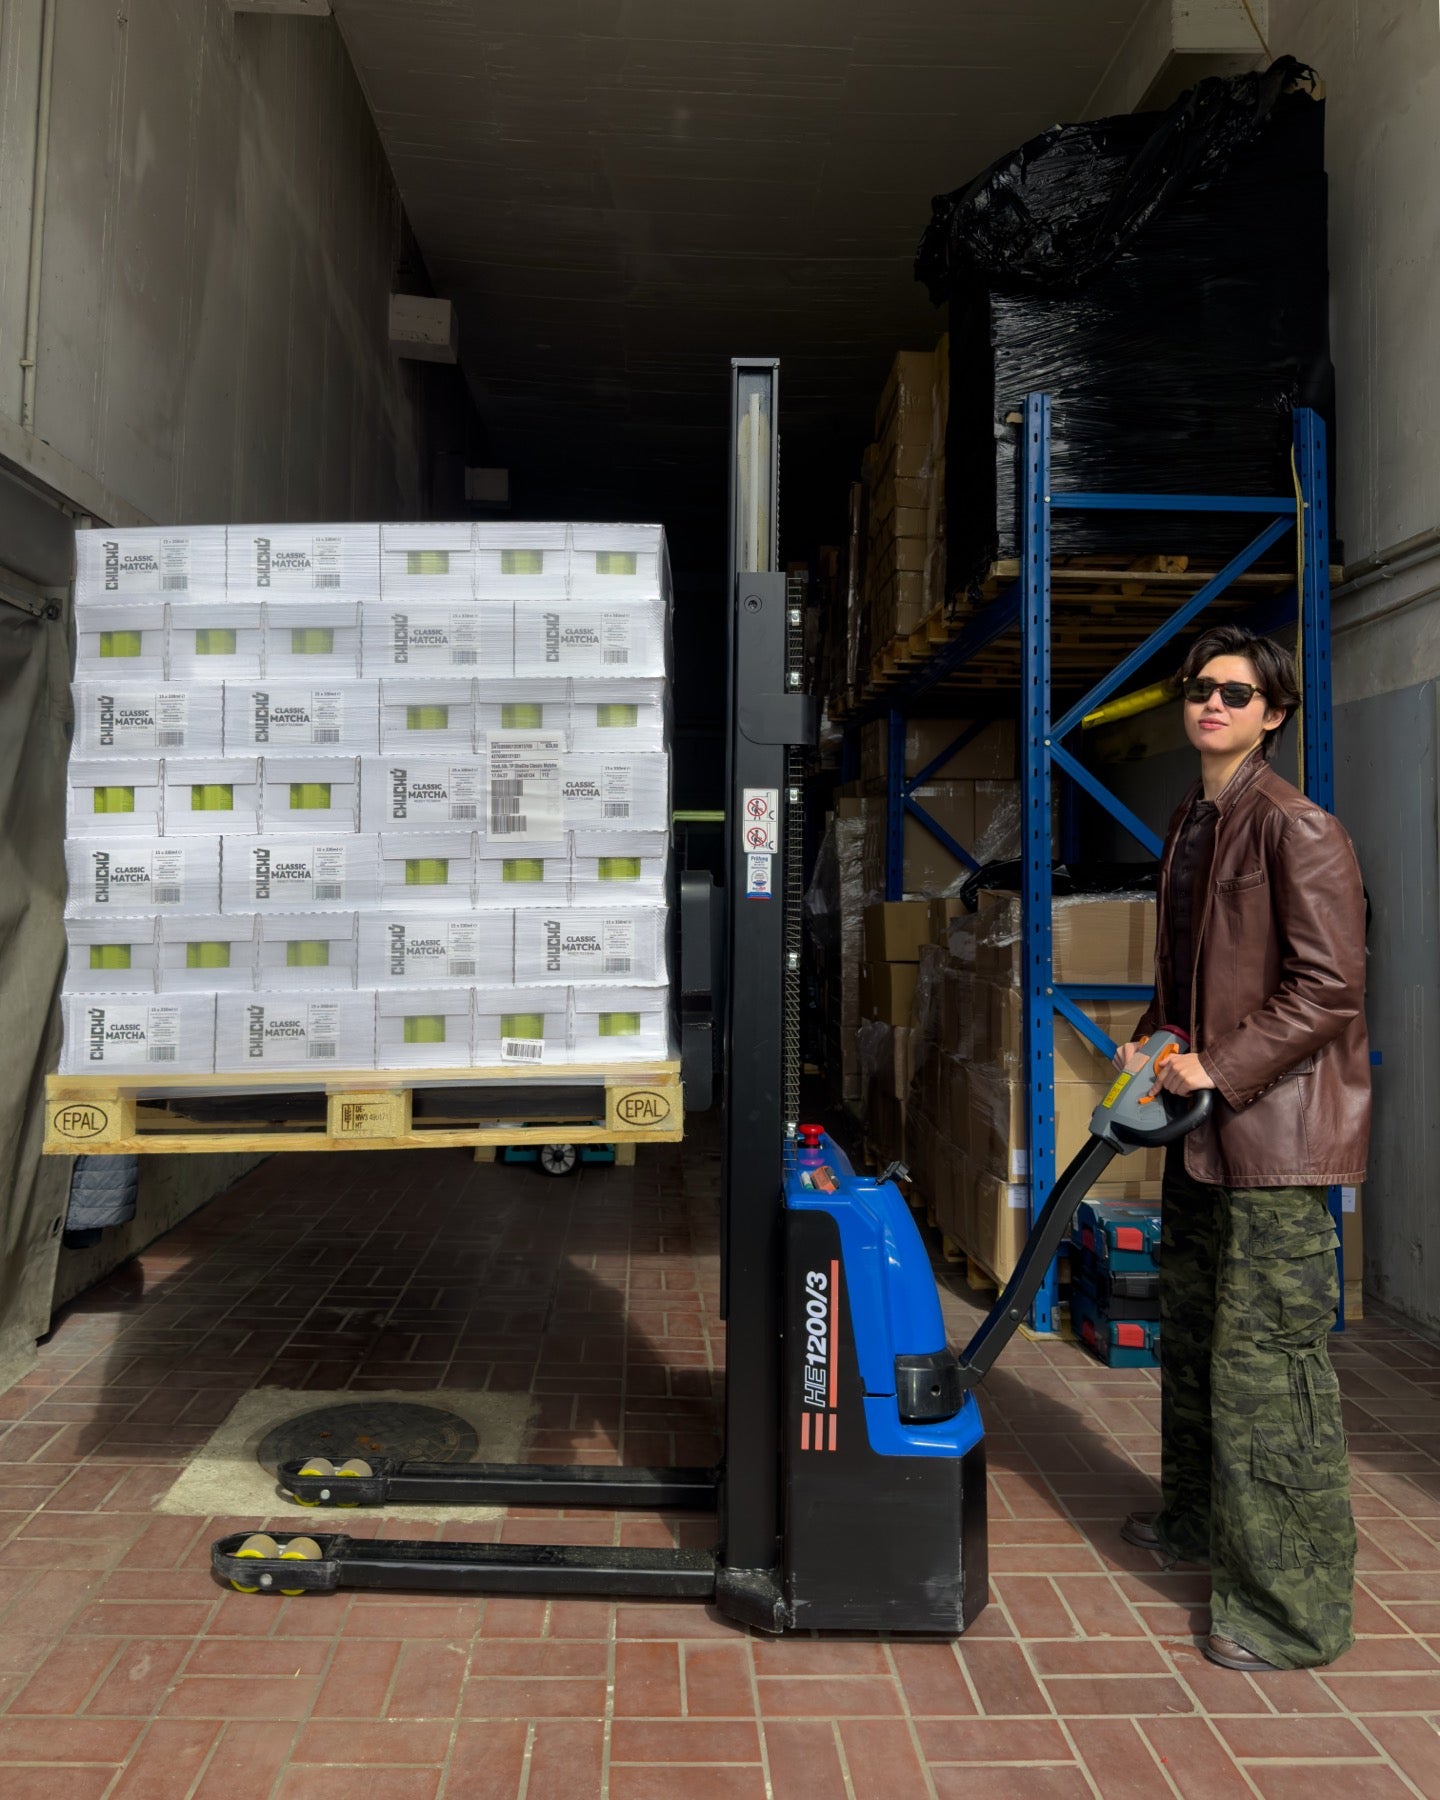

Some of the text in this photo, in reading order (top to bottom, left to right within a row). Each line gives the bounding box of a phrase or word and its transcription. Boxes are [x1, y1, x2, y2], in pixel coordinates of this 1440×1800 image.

[120, 562, 158, 570] MATCHA
[272, 560, 311, 568] MATCHA
[409, 636, 448, 644] MATCHA
[115, 718, 154, 726] MATCHA
[110, 874, 150, 882] MATCHA
[406, 947, 446, 955] MATCHA
[270, 1020, 301, 1028] CLASSIC
[106, 1032, 146, 1040] MATCHA
[265, 1028, 305, 1036] MATCHA
[626, 1100, 662, 1118] EPAL
[63, 1112, 100, 1130] EPAL
[804, 1271, 828, 1408] HE1200/3
